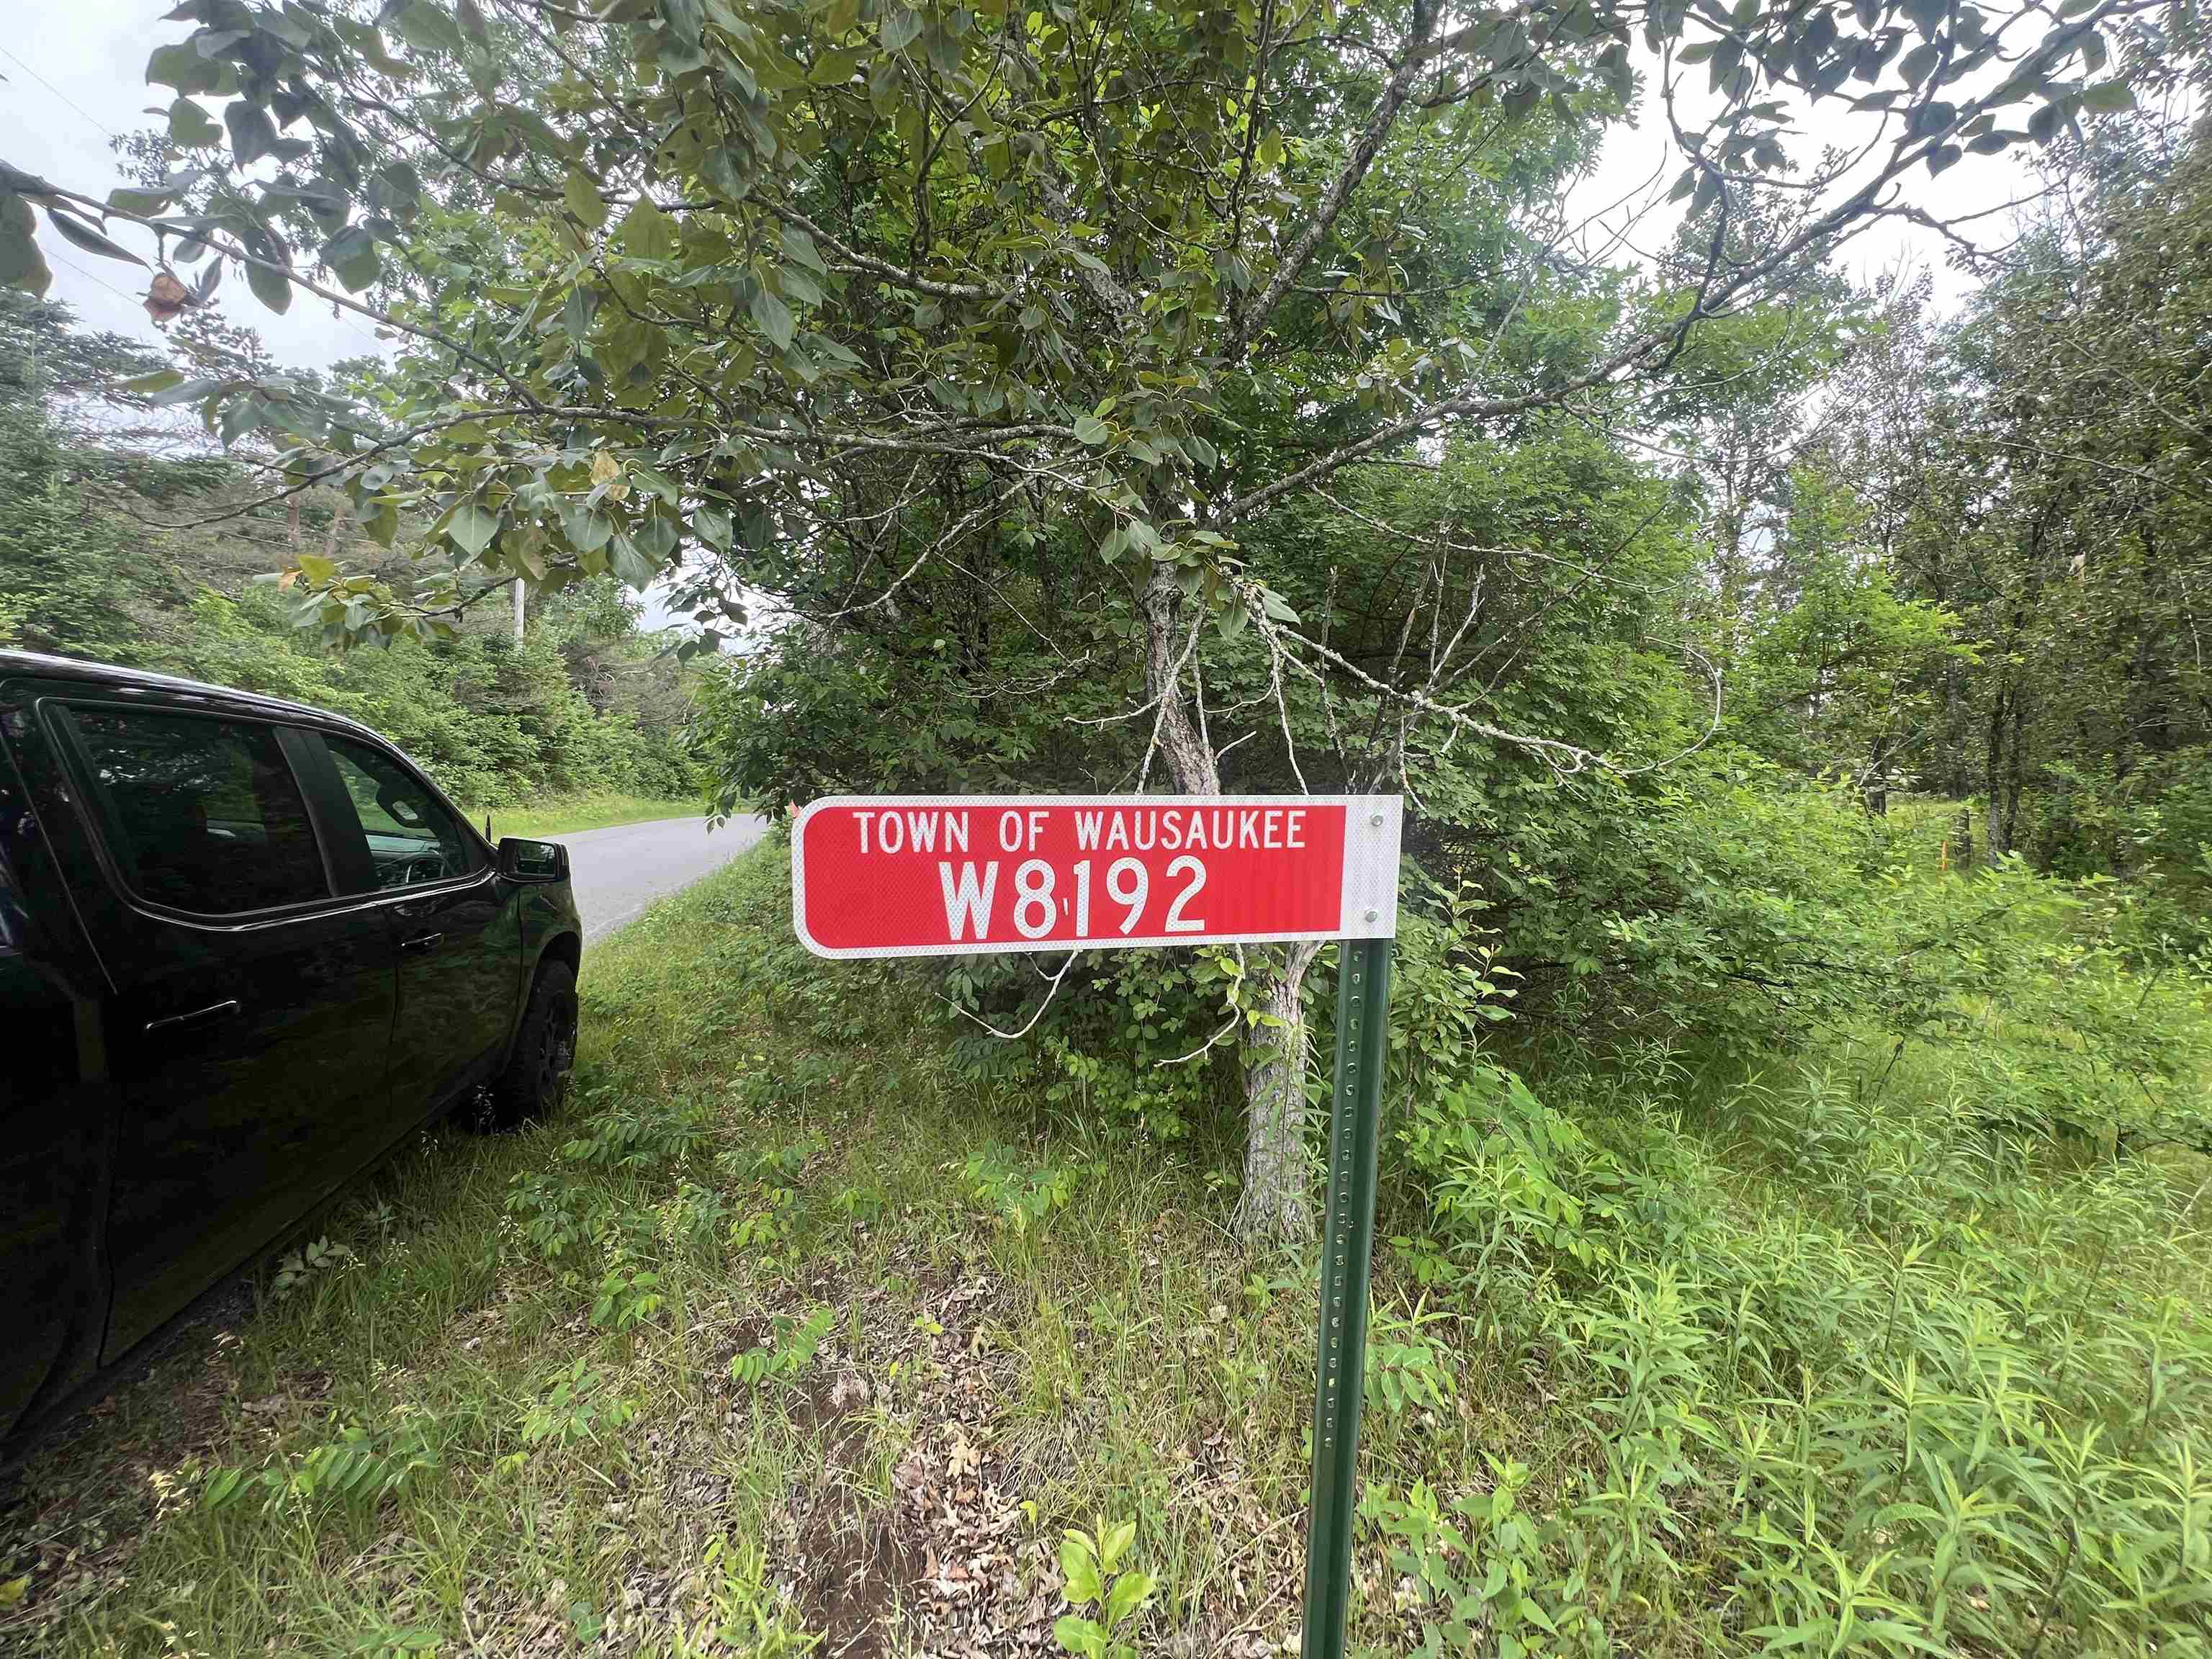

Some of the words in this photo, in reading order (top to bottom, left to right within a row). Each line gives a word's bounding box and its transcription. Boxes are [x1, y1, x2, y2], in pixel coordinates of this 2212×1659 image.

[852, 811, 968, 854] TOWN
[999, 810, 1050, 853] OF
[1074, 810, 1306, 850] WAUSAUKEE
